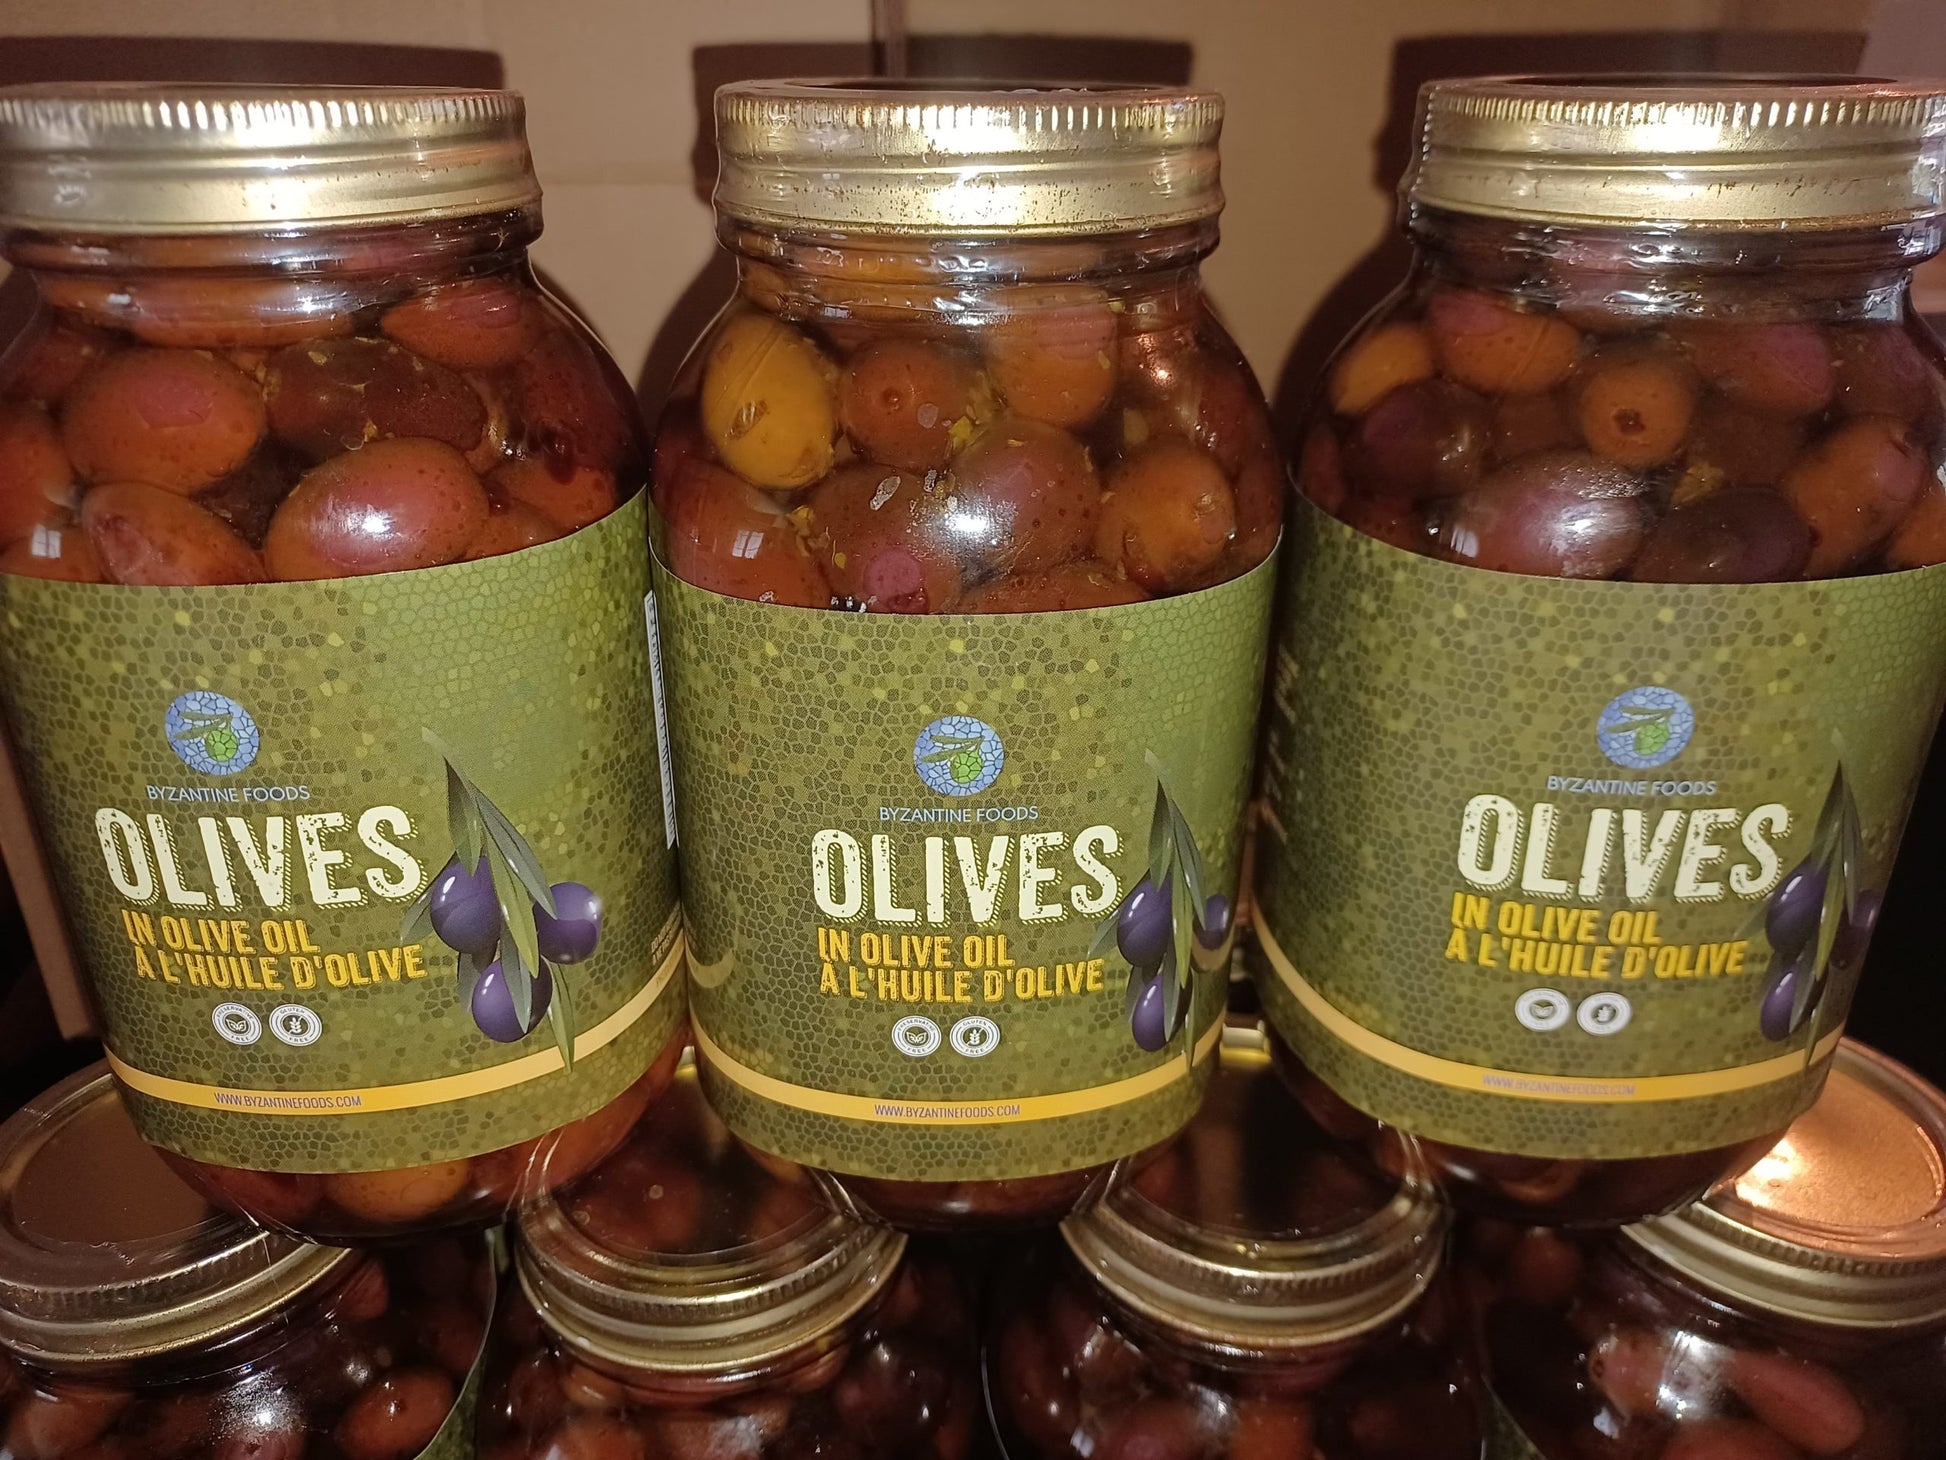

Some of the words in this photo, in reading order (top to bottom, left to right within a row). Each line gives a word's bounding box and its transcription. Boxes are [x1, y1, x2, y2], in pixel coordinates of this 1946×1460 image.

[146, 785, 238, 802] BYZANTINE
[243, 785, 311, 802] FOODS
[1547, 775, 1646, 796] BYZANTINE
[1651, 778, 1718, 797] FOODS
[879, 806, 971, 823] BYZANTINE
[976, 806, 1039, 822] FOODS
[94, 805, 428, 912] OLIVES
[1457, 793, 1793, 904] OLIVES
[811, 824, 1124, 927] OLIVES
[121, 908, 157, 947] IN
[160, 915, 257, 955] OLIVE
[261, 919, 321, 955] OIL
[1451, 891, 1490, 930] IN
[1497, 901, 1601, 944] OLIVE
[1607, 910, 1663, 945] OIL
[157, 950, 290, 990] L'HUILE
[290, 944, 429, 989] D'OLIVE
[817, 927, 851, 963] IN
[860, 933, 953, 968] OLIVE
[963, 934, 1016, 969] OIL
[1478, 933, 1613, 980] L'HUILE
[1621, 940, 1749, 980] D'OLIVE
[848, 965, 973, 1003] L'HUILE
[983, 958, 1105, 1002] D'OLIVE
[213, 1092, 362, 1109] WWW.BYZANTINEFOODS.COM
[874, 1104, 1021, 1119] WWW.BYZANTINEFOODS.COM
